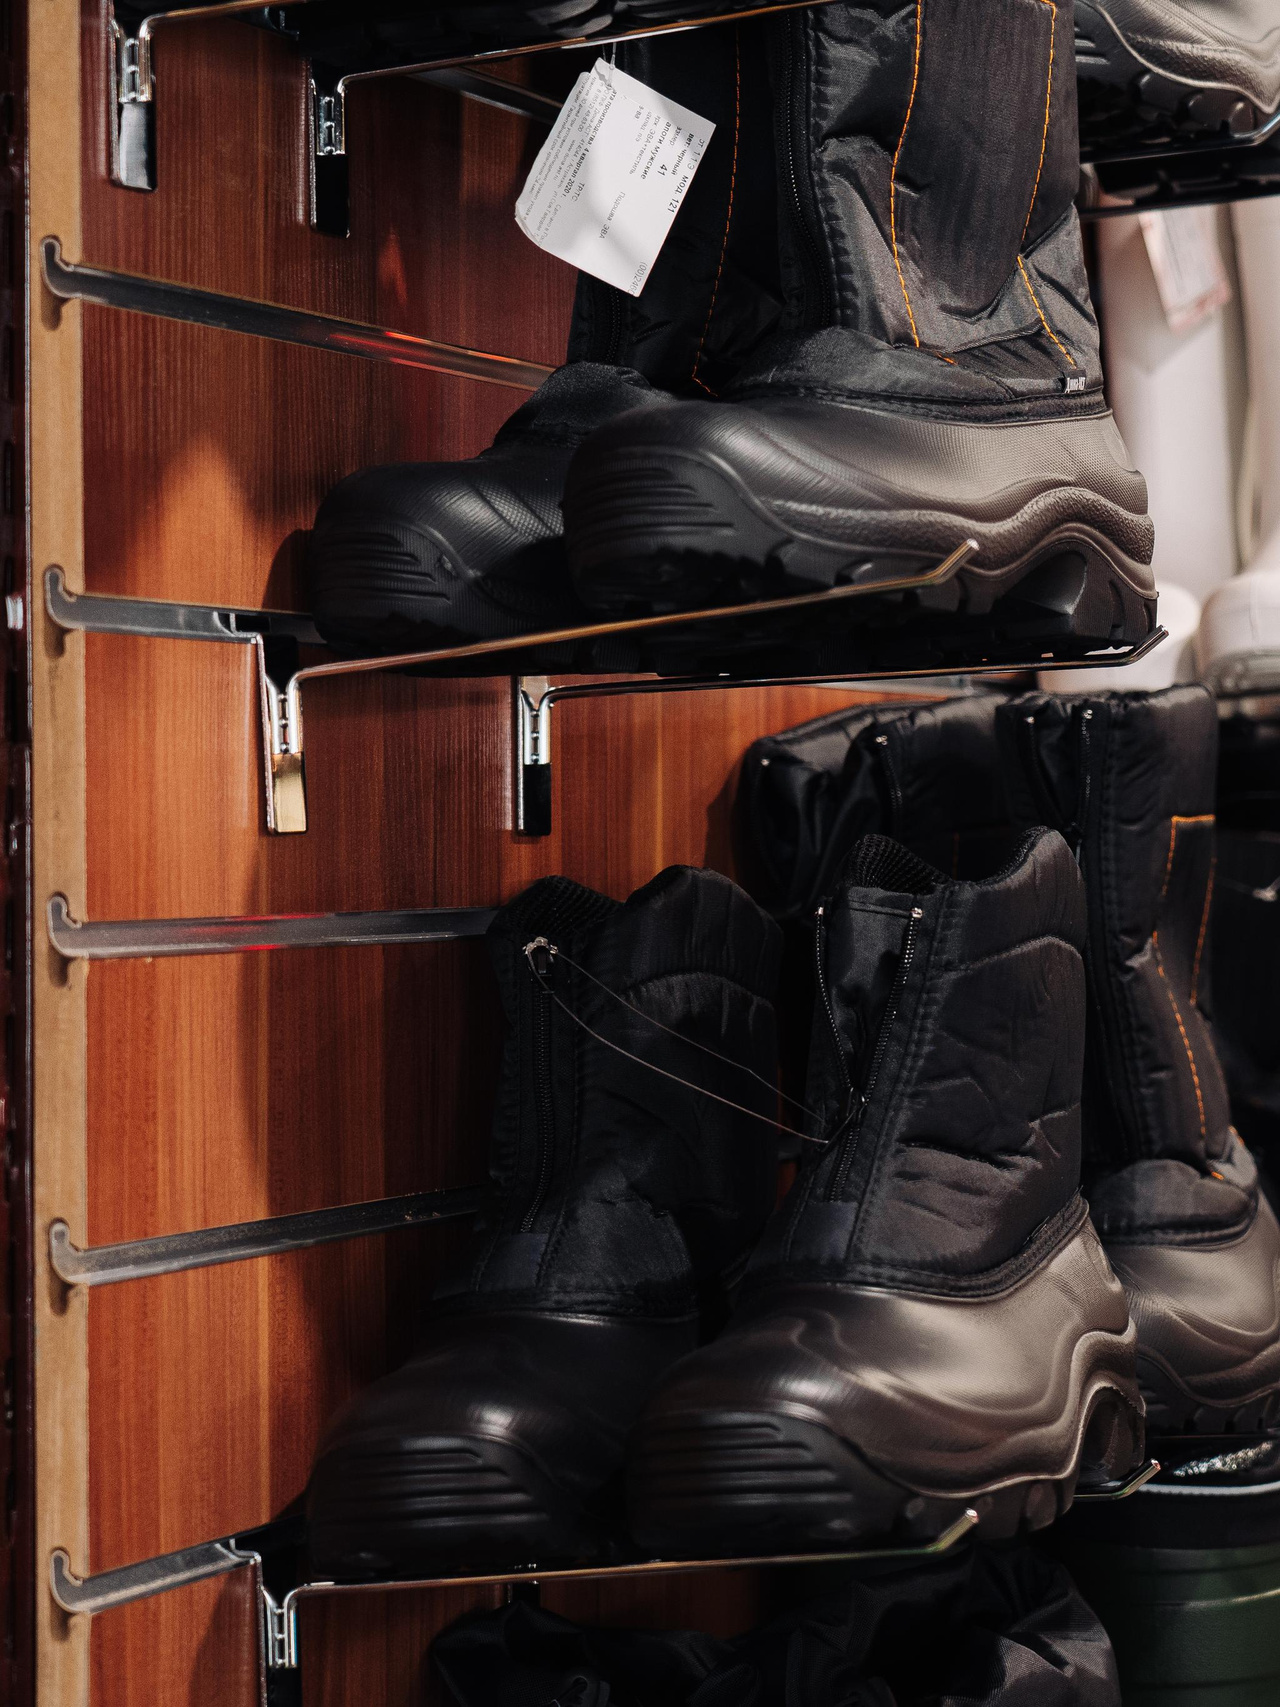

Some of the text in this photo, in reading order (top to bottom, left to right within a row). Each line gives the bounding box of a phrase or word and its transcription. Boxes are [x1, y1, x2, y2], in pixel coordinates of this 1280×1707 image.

[569, 151, 587, 178] квартал
[637, 144, 660, 180] мужские
[656, 163, 668, 177] 41
[668, 147, 688, 176] черный
[562, 178, 575, 194] 2020
[673, 174, 689, 196] мод.
[666, 197, 679, 213] 121
[597, 223, 610, 239] ЭВА
